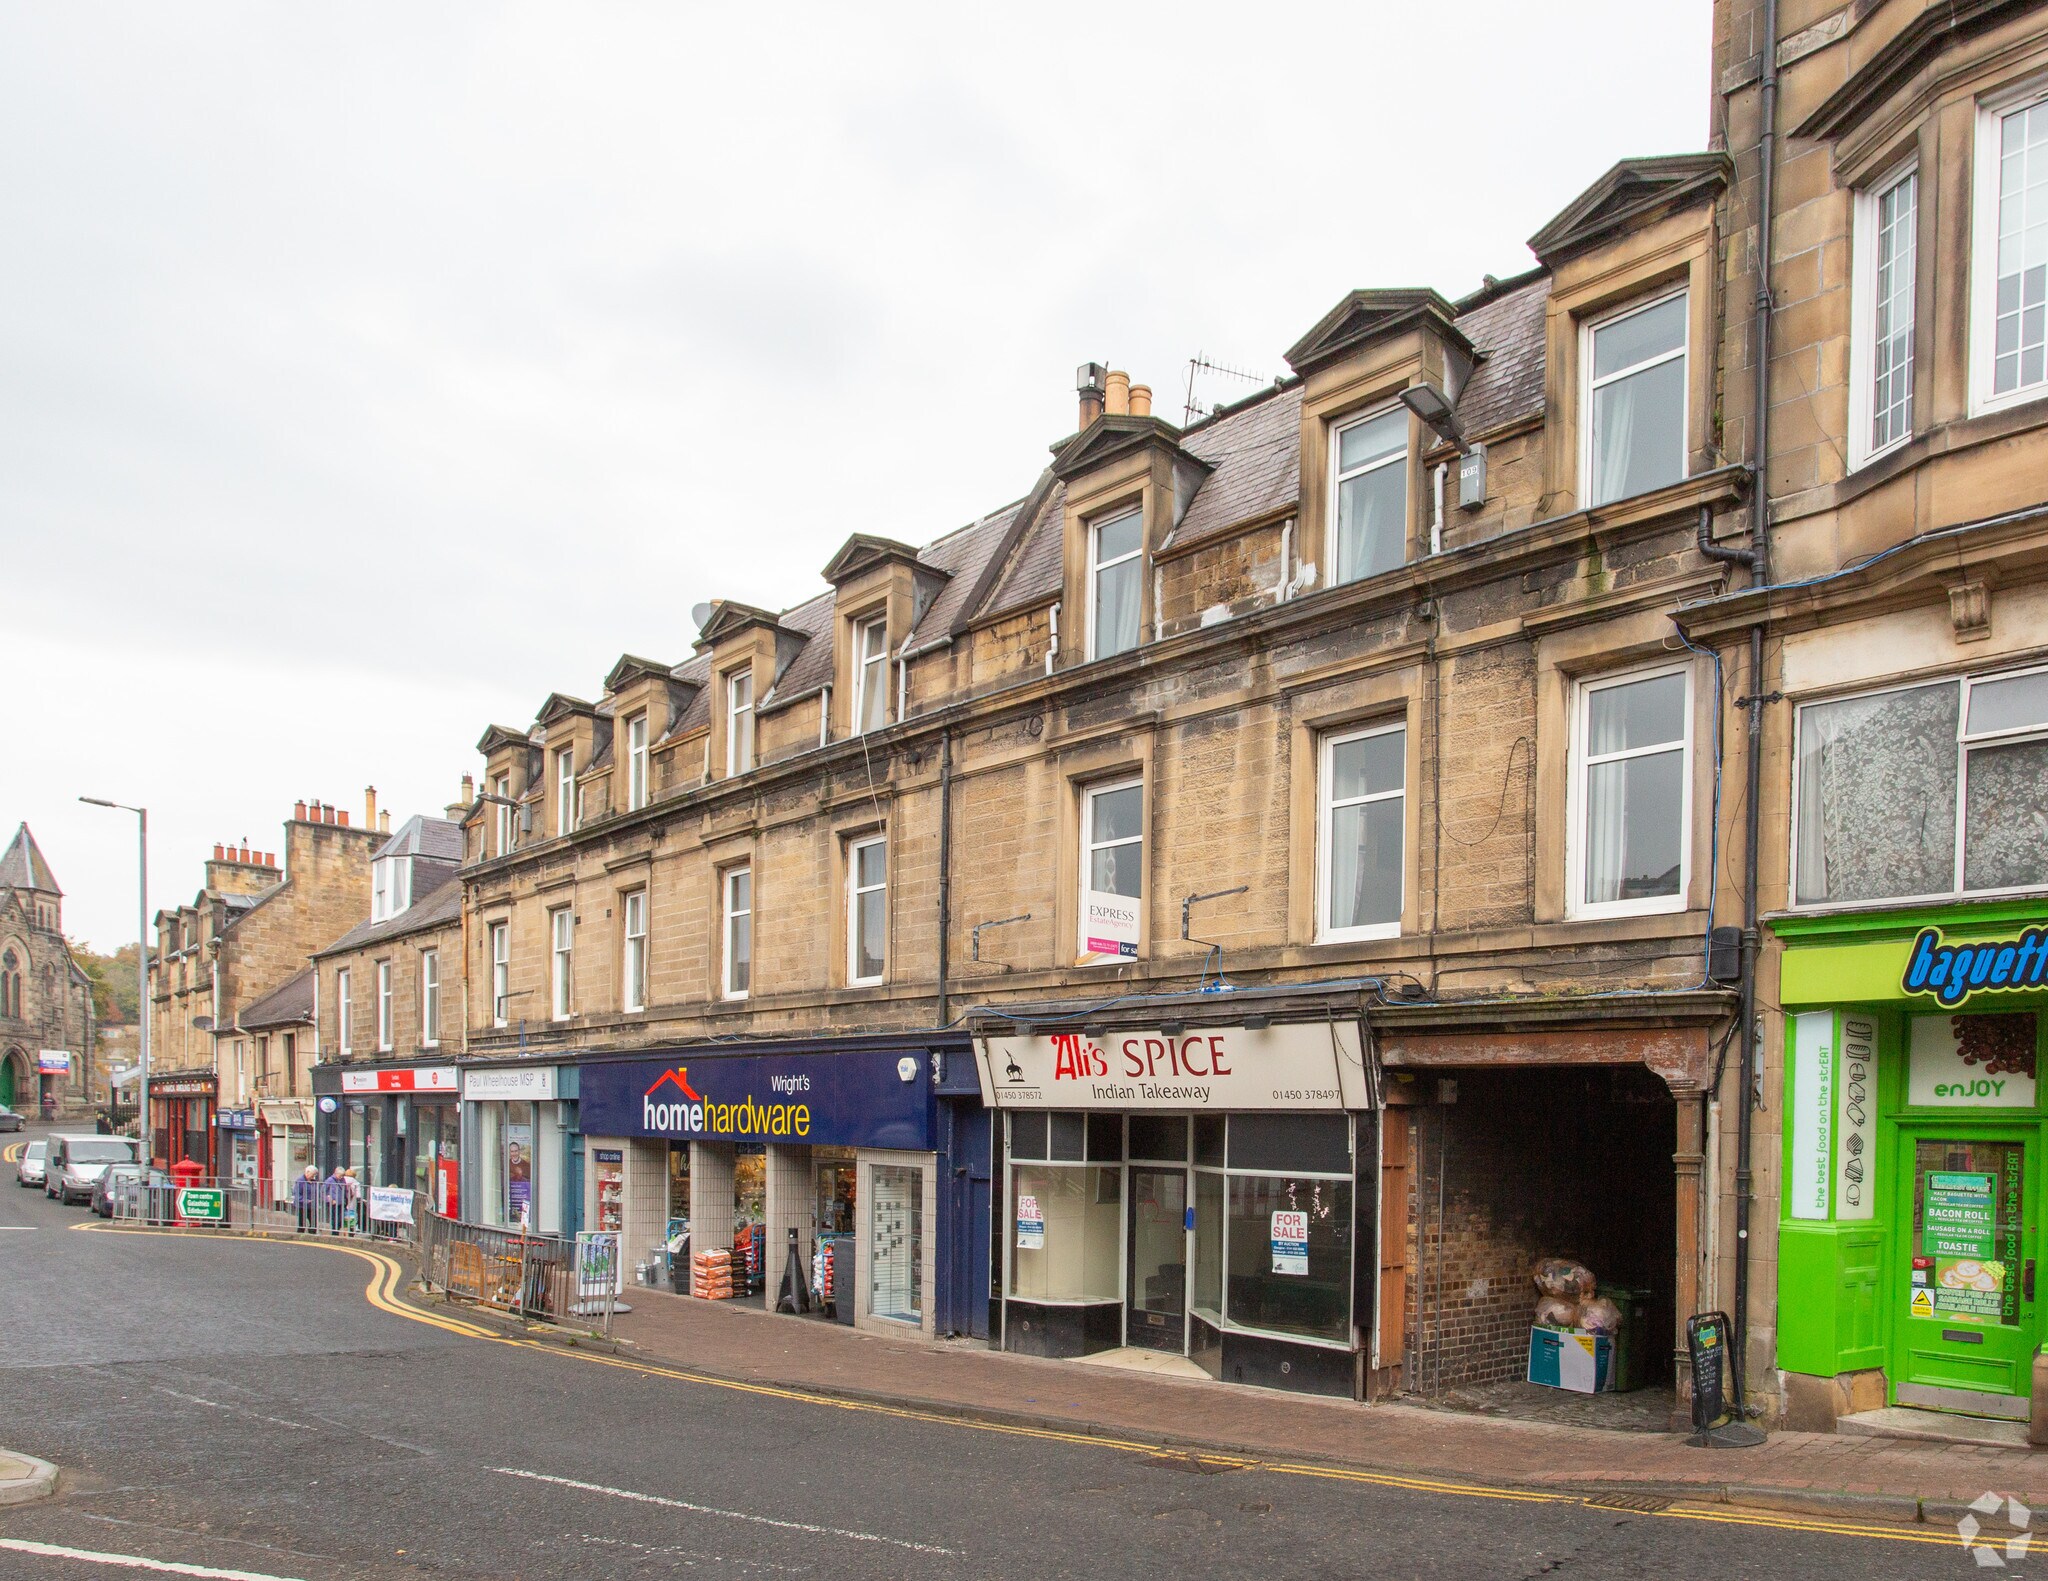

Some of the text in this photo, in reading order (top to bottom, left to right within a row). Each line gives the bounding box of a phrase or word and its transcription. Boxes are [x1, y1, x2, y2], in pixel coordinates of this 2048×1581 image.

[1462, 467, 1478, 476] 109
[1089, 905, 1134, 922] EXPRESS
[1121, 944, 1129, 953] for
[1909, 935, 2048, 999] baguett
[1122, 1036, 1232, 1078] SPICE
[469, 1073, 534, 1087] Paul Wheelhouse MSP
[771, 1074, 810, 1096] Wright's
[996, 1091, 1042, 1100] 01450 378572
[1091, 1083, 1210, 1103] Indian Takeaway
[1272, 1089, 1340, 1100] 01450 378497
[1818, 1085, 1828, 1107] the
[1934, 1080, 2005, 1097] enJOY
[1821, 1109, 1828, 1124] on
[1817, 1126, 1828, 1154] food
[1816, 1157, 1826, 1184] best
[1020, 1198, 1039, 1208] FOR
[1816, 1187, 1825, 1208] the
[2006, 1191, 2018, 1212] the
[187, 1207, 209, 1215] Edinburgh
[1018, 1209, 1042, 1219] SALE
[1928, 1208, 1990, 1220] BACON ROLL
[1276, 1213, 1301, 1226] FOR
[2008, 1214, 2017, 1230] on
[1273, 1226, 1305, 1239] SALE
[1938, 1241, 1978, 1252] TOASTIE
[2005, 1232, 2017, 1261] food
[2004, 1263, 2015, 1293] best
[2003, 1294, 2014, 1317] the
